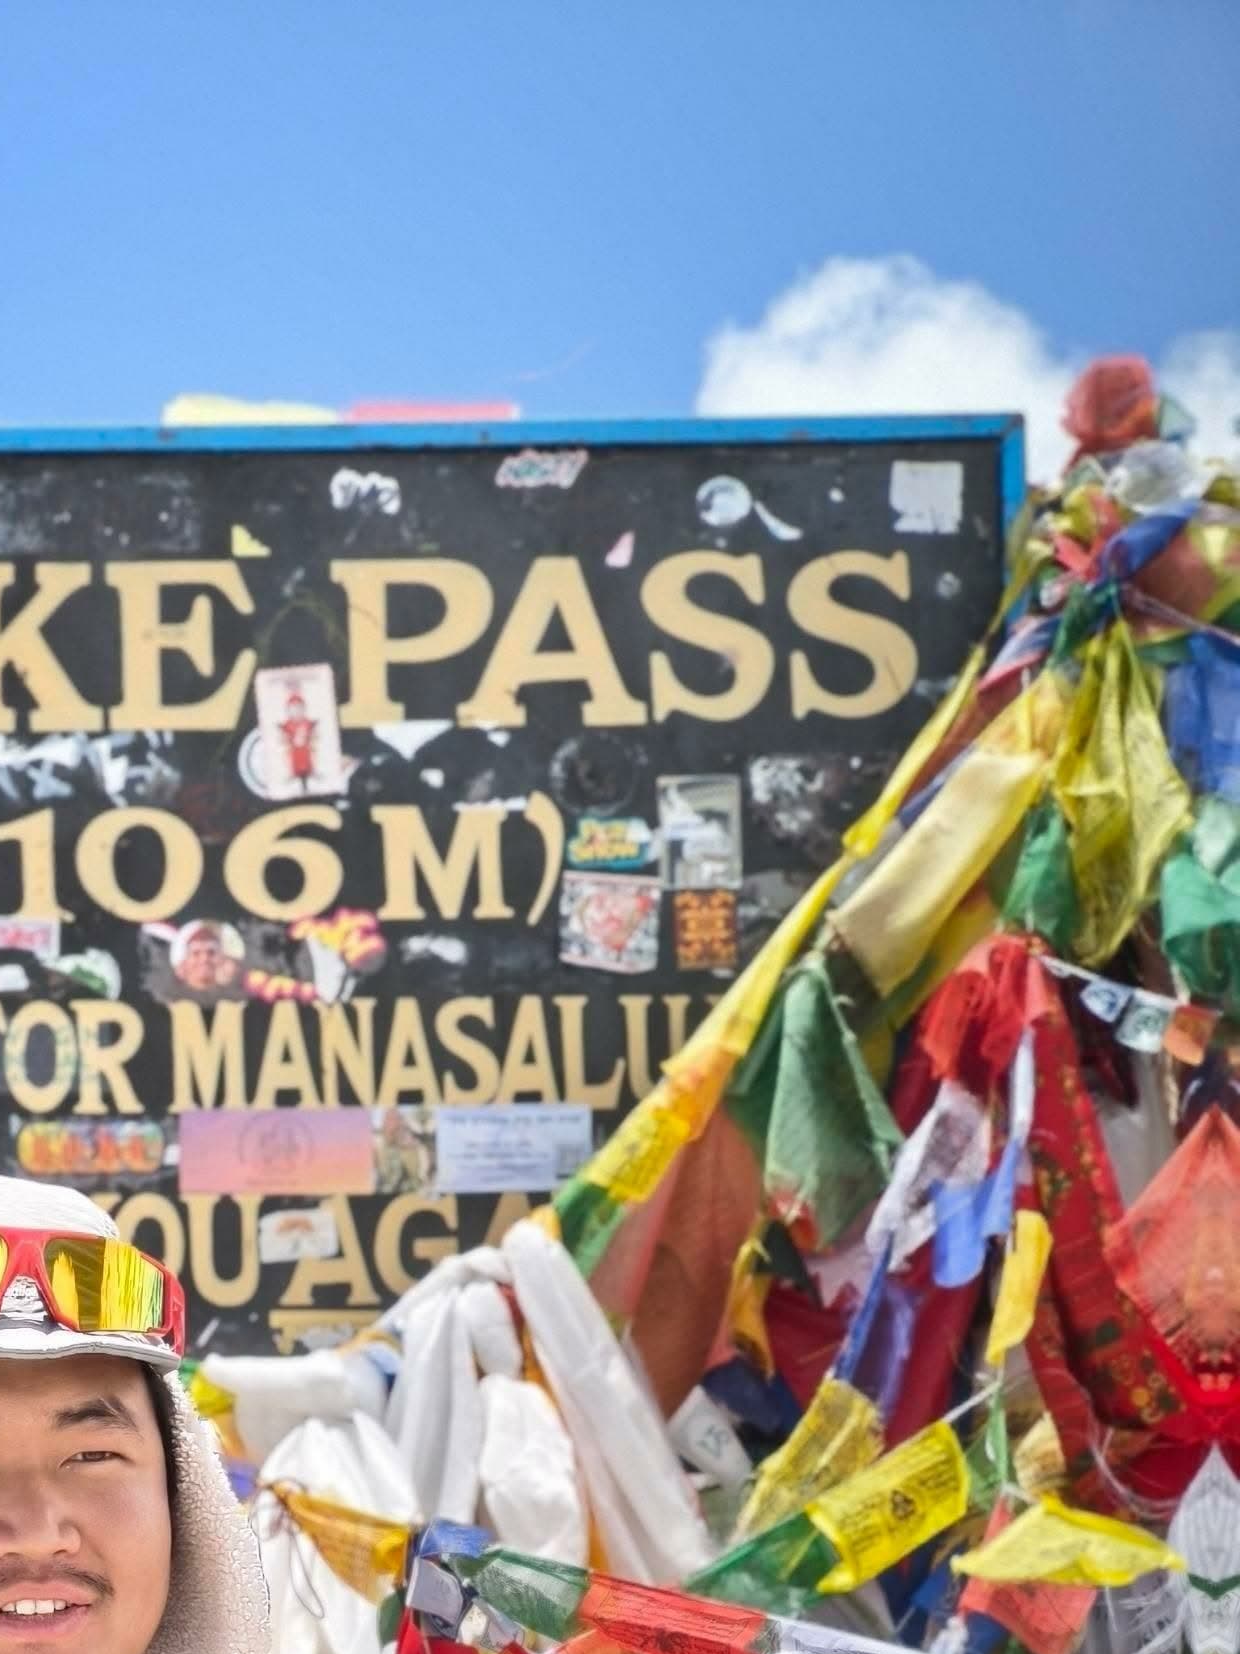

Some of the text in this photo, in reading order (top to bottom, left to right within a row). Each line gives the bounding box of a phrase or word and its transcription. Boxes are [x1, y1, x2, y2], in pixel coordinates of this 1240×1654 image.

[329, 550, 919, 728] PASS
[370, 791, 564, 927] M)
[168, 994, 692, 1111] MANASALU
